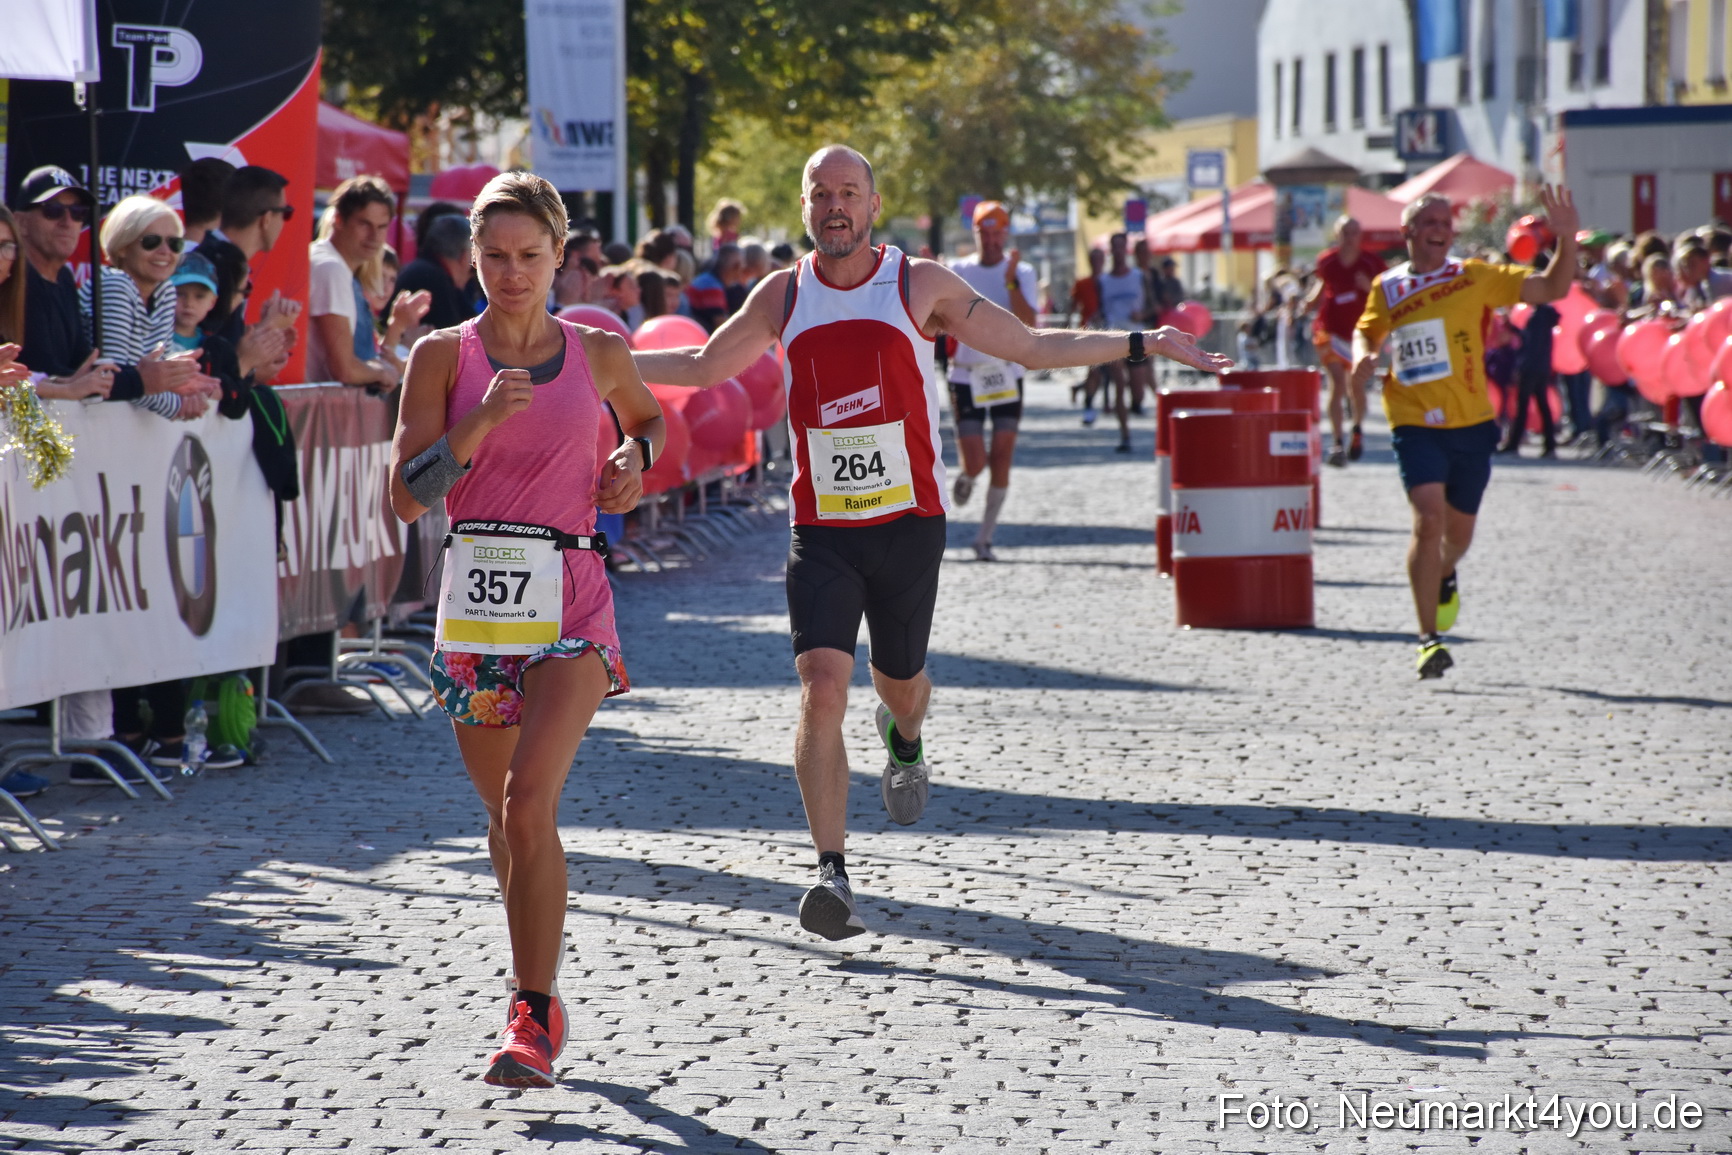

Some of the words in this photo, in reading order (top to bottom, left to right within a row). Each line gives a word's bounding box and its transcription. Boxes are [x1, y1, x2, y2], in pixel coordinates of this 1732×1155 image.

[118, 31, 145, 42] Team
[121, 167, 176, 189] NEXT
[1391, 298, 1425, 323] MAX
[1399, 337, 1437, 361] 2415
[836, 397, 863, 415] DEHN
[833, 434, 876, 446] BOCK
[831, 450, 886, 481] 264
[853, 482, 883, 492] Neumarkt
[845, 495, 883, 510] Rainer
[458, 522, 497, 533] PROFILE
[499, 523, 546, 536] DESIGN
[473, 546, 526, 560] BOCK
[468, 568, 531, 605] 357
[465, 608, 488, 617] PARTL
[489, 610, 525, 618] Neumarkt
